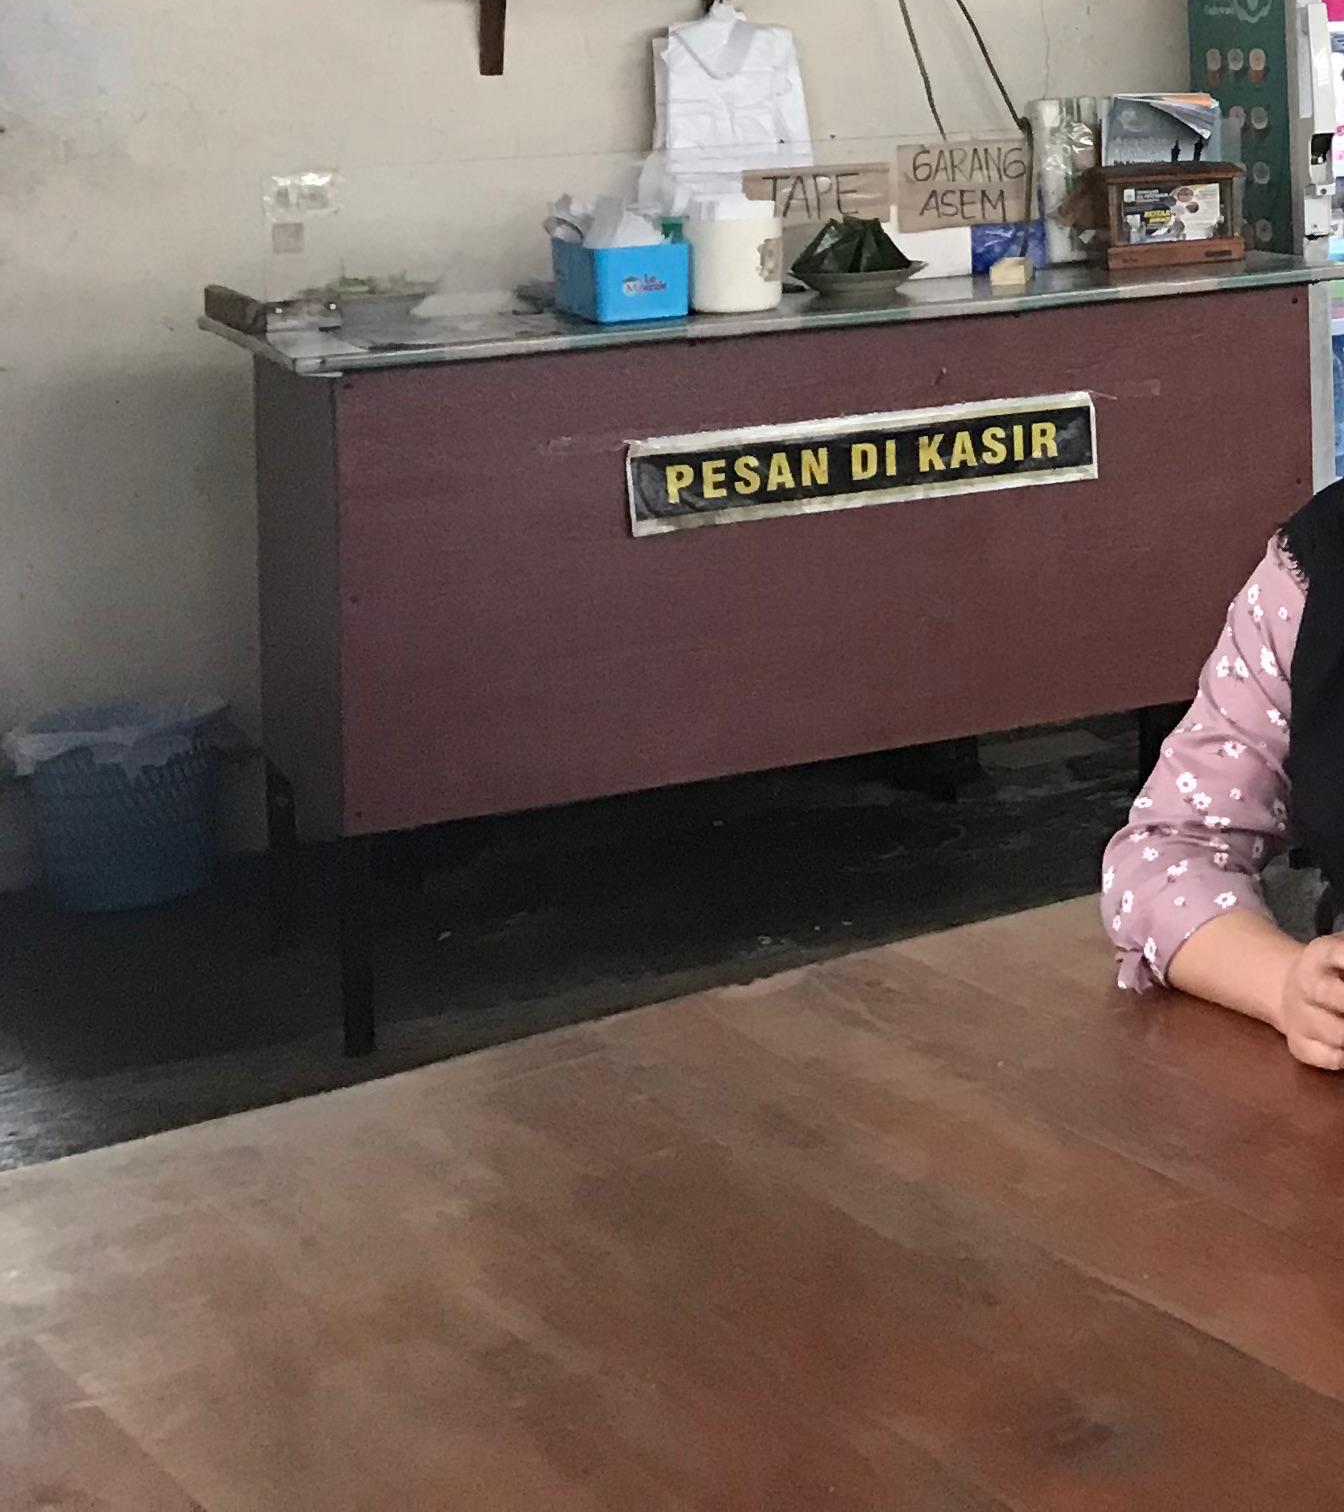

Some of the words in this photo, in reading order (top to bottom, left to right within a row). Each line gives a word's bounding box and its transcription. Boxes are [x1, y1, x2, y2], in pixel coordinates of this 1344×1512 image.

[912, 147, 1027, 183] GARANG
[762, 173, 859, 218] TAPE
[920, 190, 1006, 222] ASEM
[665, 452, 829, 504] PESAN
[851, 440, 896, 480] DI
[918, 421, 1059, 472] KASIR
